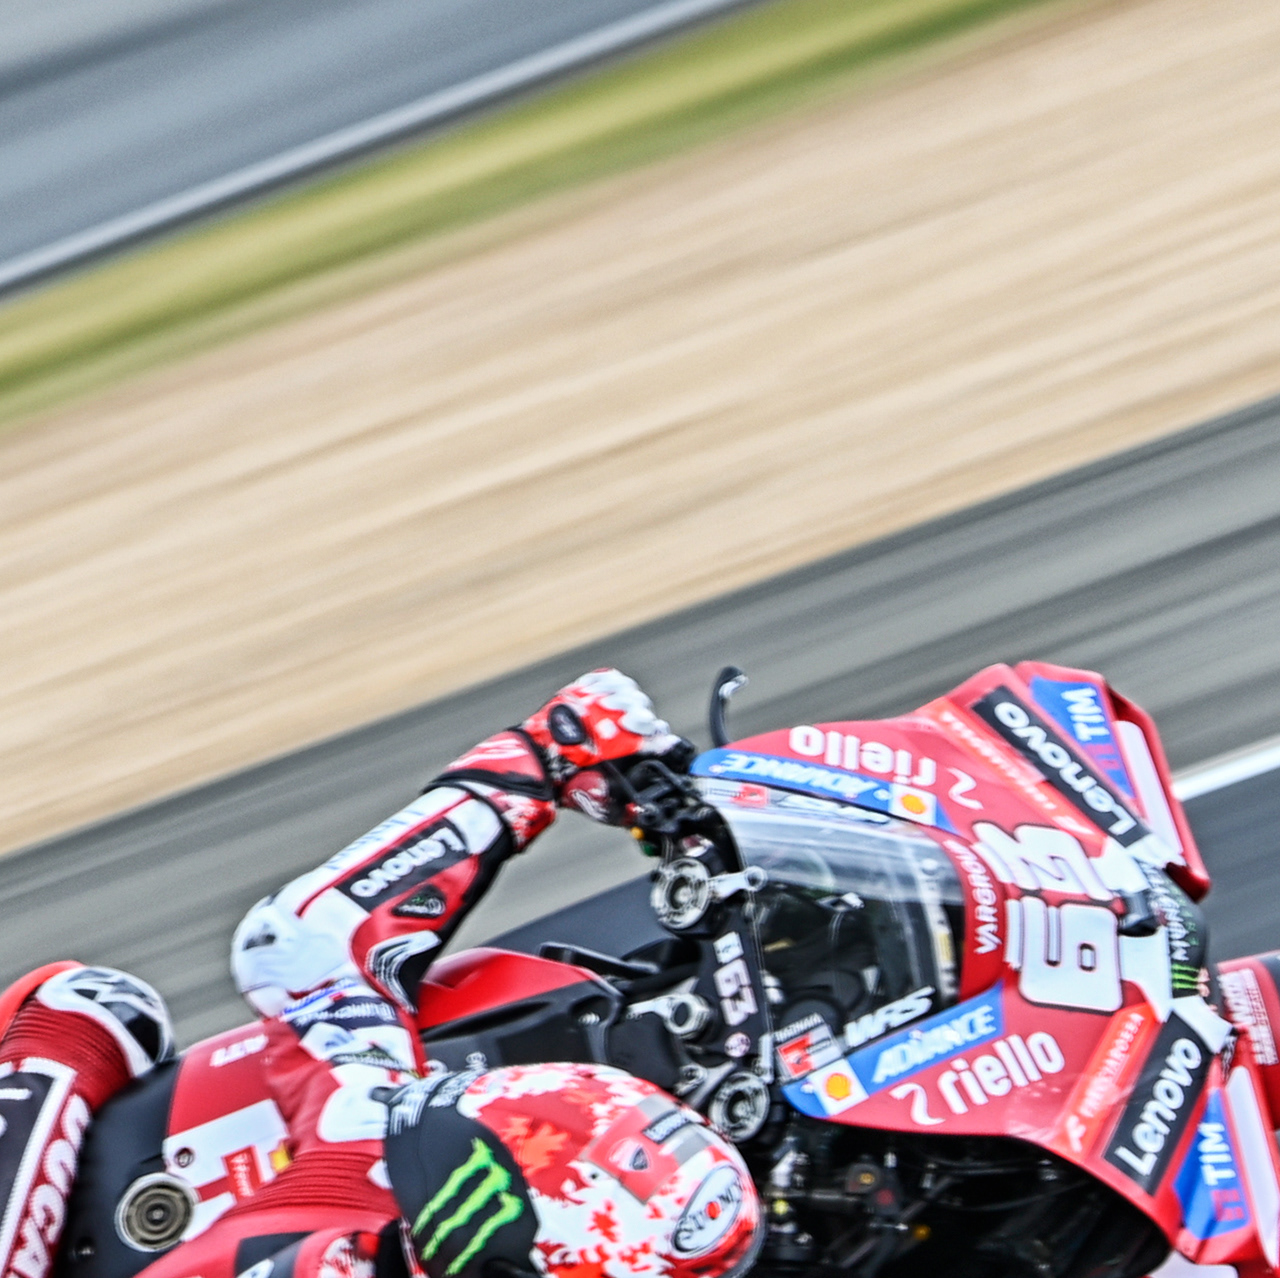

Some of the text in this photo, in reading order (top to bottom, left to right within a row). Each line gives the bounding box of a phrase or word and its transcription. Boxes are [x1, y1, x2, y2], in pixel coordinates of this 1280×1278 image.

[1060, 687, 1110, 742] TIM
[788, 725, 937, 787] riello
[994, 702, 1138, 836] Lenovo
[350, 826, 468, 898] Lenovo
[972, 820, 1124, 1013] 63
[872, 1004, 997, 1084] ADVANCE
[937, 1031, 1065, 1115] riello
[1114, 1037, 1202, 1176] Lenovo
[1196, 1121, 1237, 1187] TIM
